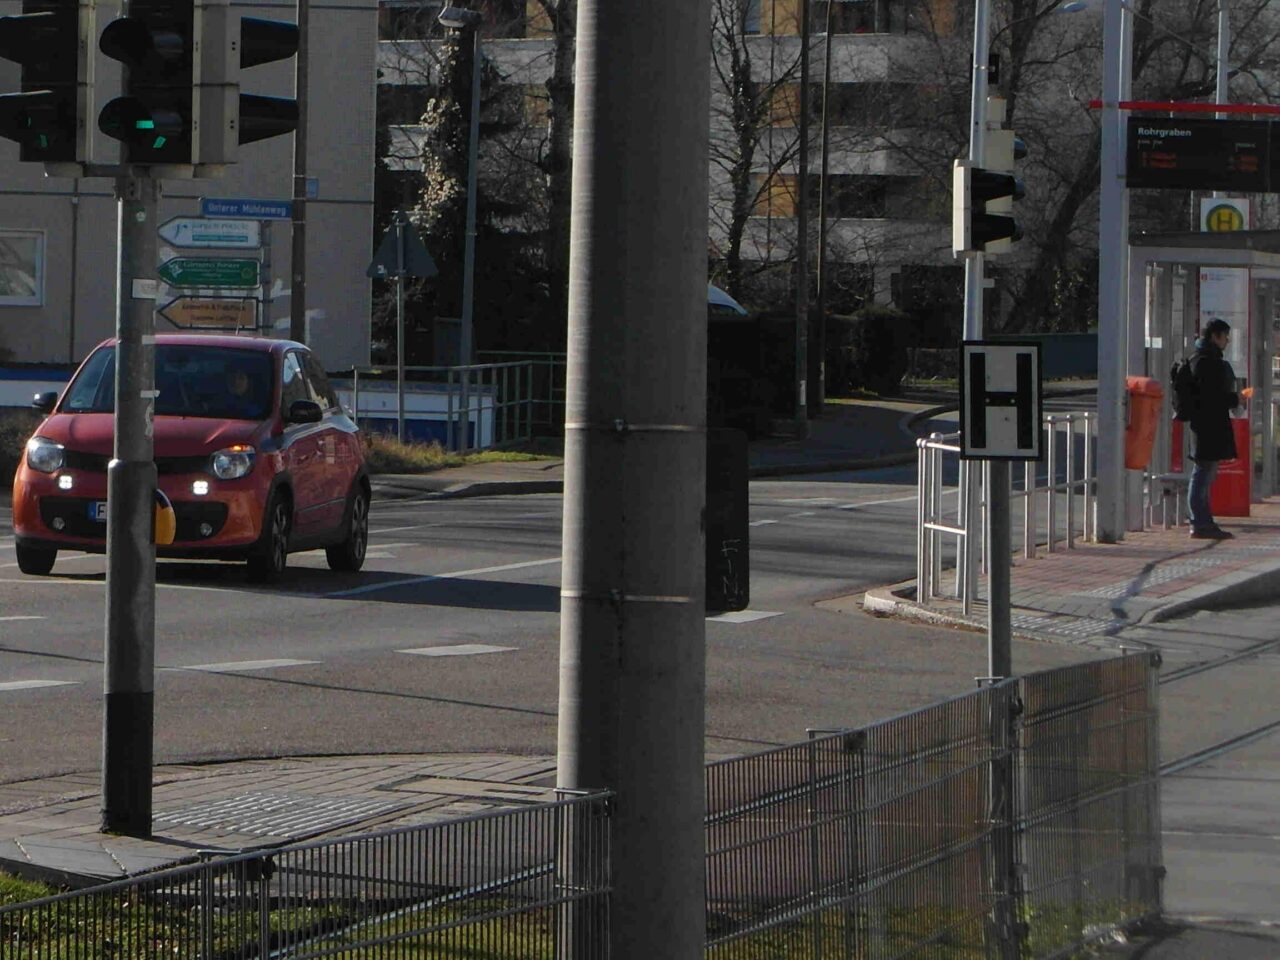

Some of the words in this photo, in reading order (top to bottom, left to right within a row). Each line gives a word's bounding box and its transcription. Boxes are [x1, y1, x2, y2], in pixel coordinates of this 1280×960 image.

[1138, 127, 1191, 137] Rohrgraben
[1217, 213, 1232, 230] H
[969, 352, 1033, 449] H
